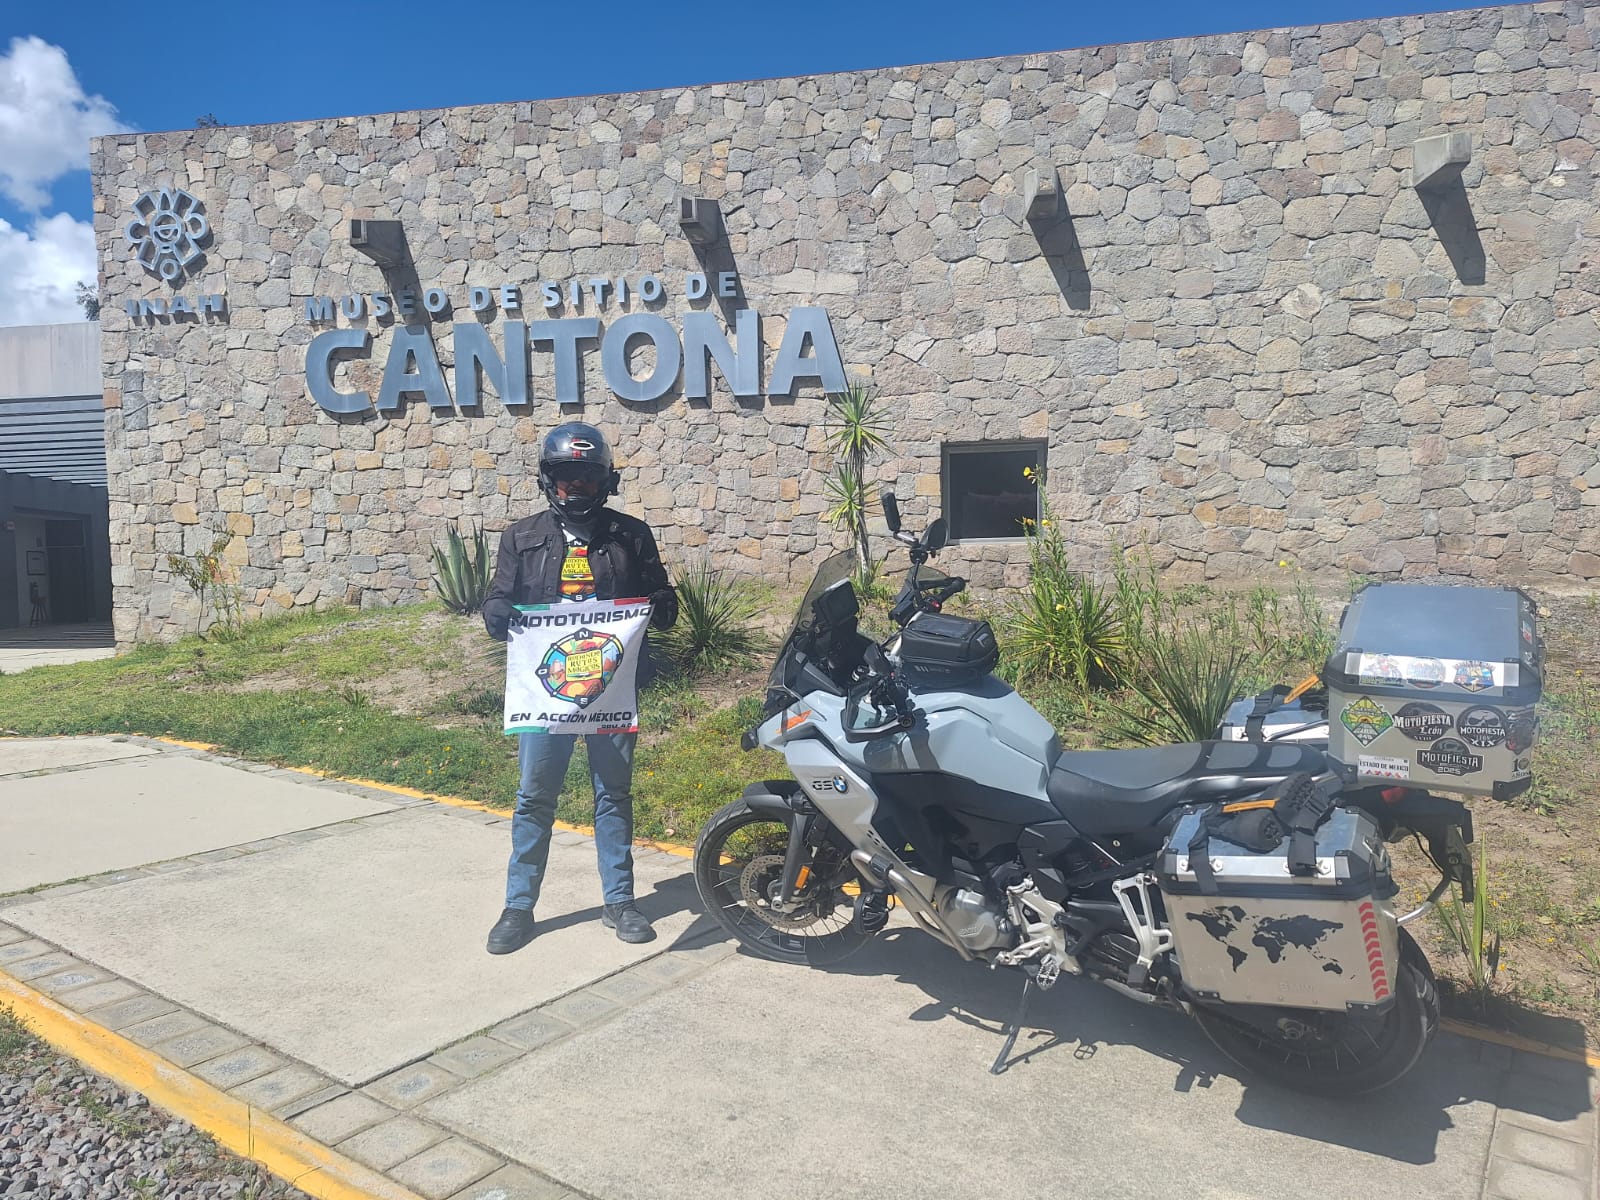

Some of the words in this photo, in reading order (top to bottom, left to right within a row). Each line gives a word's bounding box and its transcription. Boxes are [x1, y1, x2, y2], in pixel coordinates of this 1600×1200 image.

[305, 287, 449, 324] MUSEO
[470, 283, 519, 313] DE
[541, 275, 664, 309] SITIO
[686, 271, 737, 301] DE
[125, 293, 226, 317] INAH
[305, 306, 848, 415] CANTONA
[511, 606, 651, 628] MOTOTURISMO
[510, 713, 531, 723] EN
[537, 711, 587, 723] ACCIÓN
[588, 710, 633, 723] MÉXICO
[1394, 714, 1452, 729] MOTOFIESTA
[1460, 726, 1506, 737] MOTOFIESTA
[1471, 738, 1496, 747] XIX
[1359, 760, 1380, 769] ESTADO
[1421, 751, 1479, 768] MOTOFIESTA
[1437, 766, 1461, 775] 2025
[812, 780, 833, 791] GS
